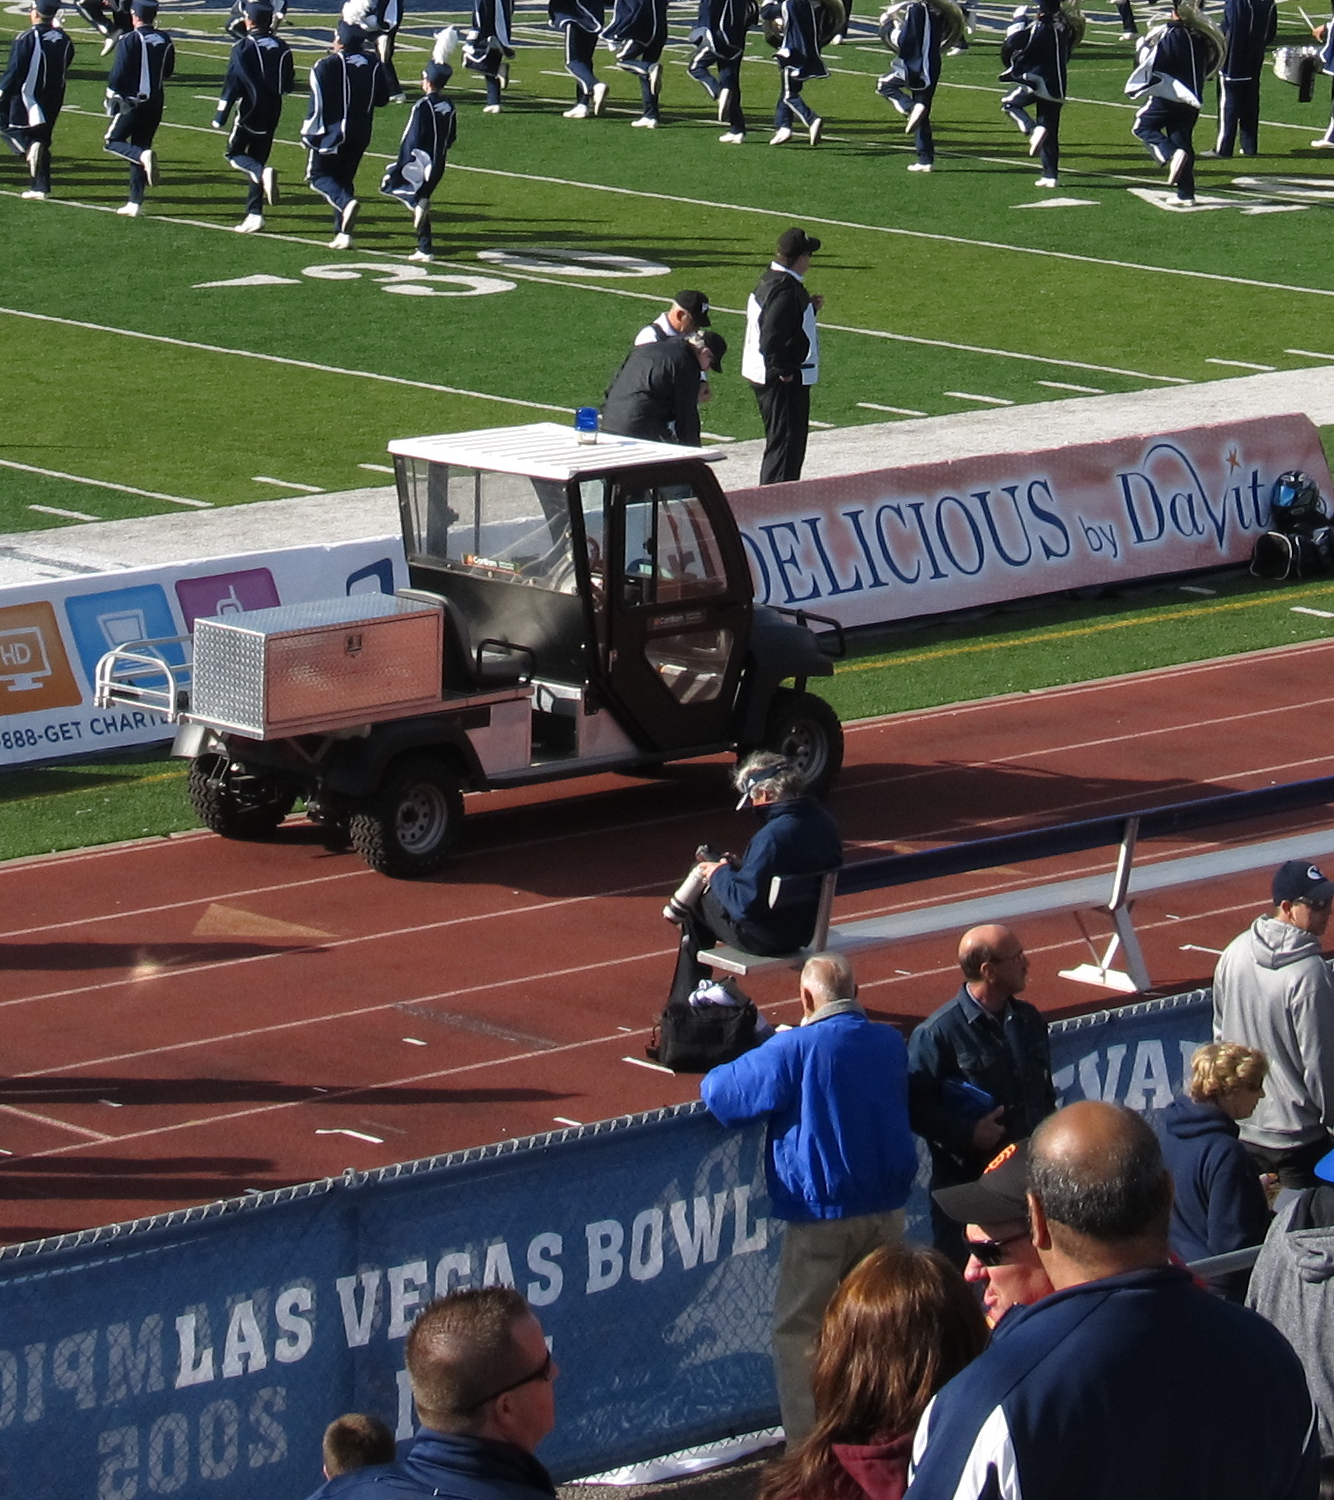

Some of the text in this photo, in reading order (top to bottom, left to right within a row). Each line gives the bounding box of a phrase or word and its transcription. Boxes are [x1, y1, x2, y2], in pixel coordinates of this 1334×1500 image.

[300, 247, 671, 298] 30
[1079, 515, 1119, 559] by
[1115, 443, 1269, 552] DaVit
[1, 643, 32, 667] HD
[88, 707, 176, 738] CHART
[174, 1286, 315, 1390] LAS
[335, 1232, 564, 1350] VEGAS
[584, 1184, 768, 1295] BOWL
